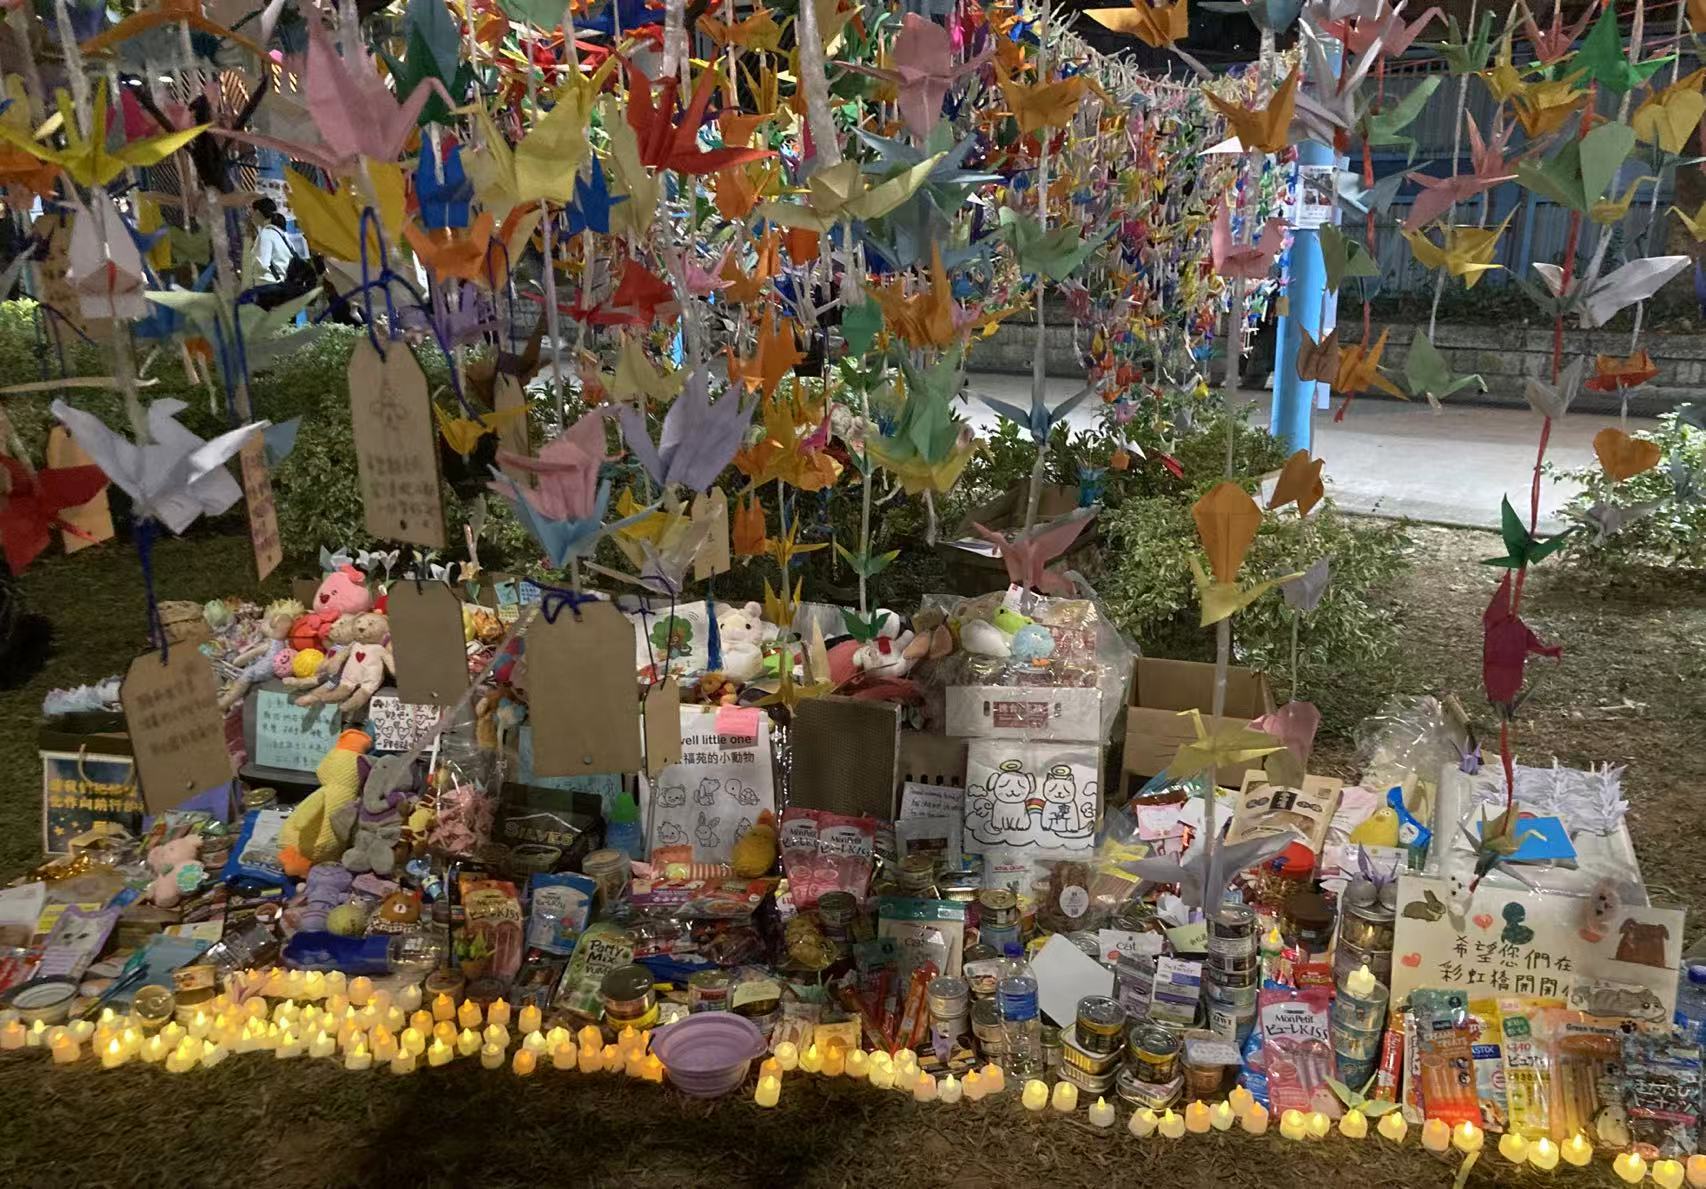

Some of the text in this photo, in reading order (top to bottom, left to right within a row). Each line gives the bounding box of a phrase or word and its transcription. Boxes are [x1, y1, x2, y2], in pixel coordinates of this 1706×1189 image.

[702, 735, 729, 745] little
[730, 735, 752, 744] one
[676, 752, 755, 764] 福苑的小動物
[1116, 942, 1137, 951] cat
[1453, 935, 1573, 972] 希望您們在
[1275, 1014, 1314, 1024] MonPetit
